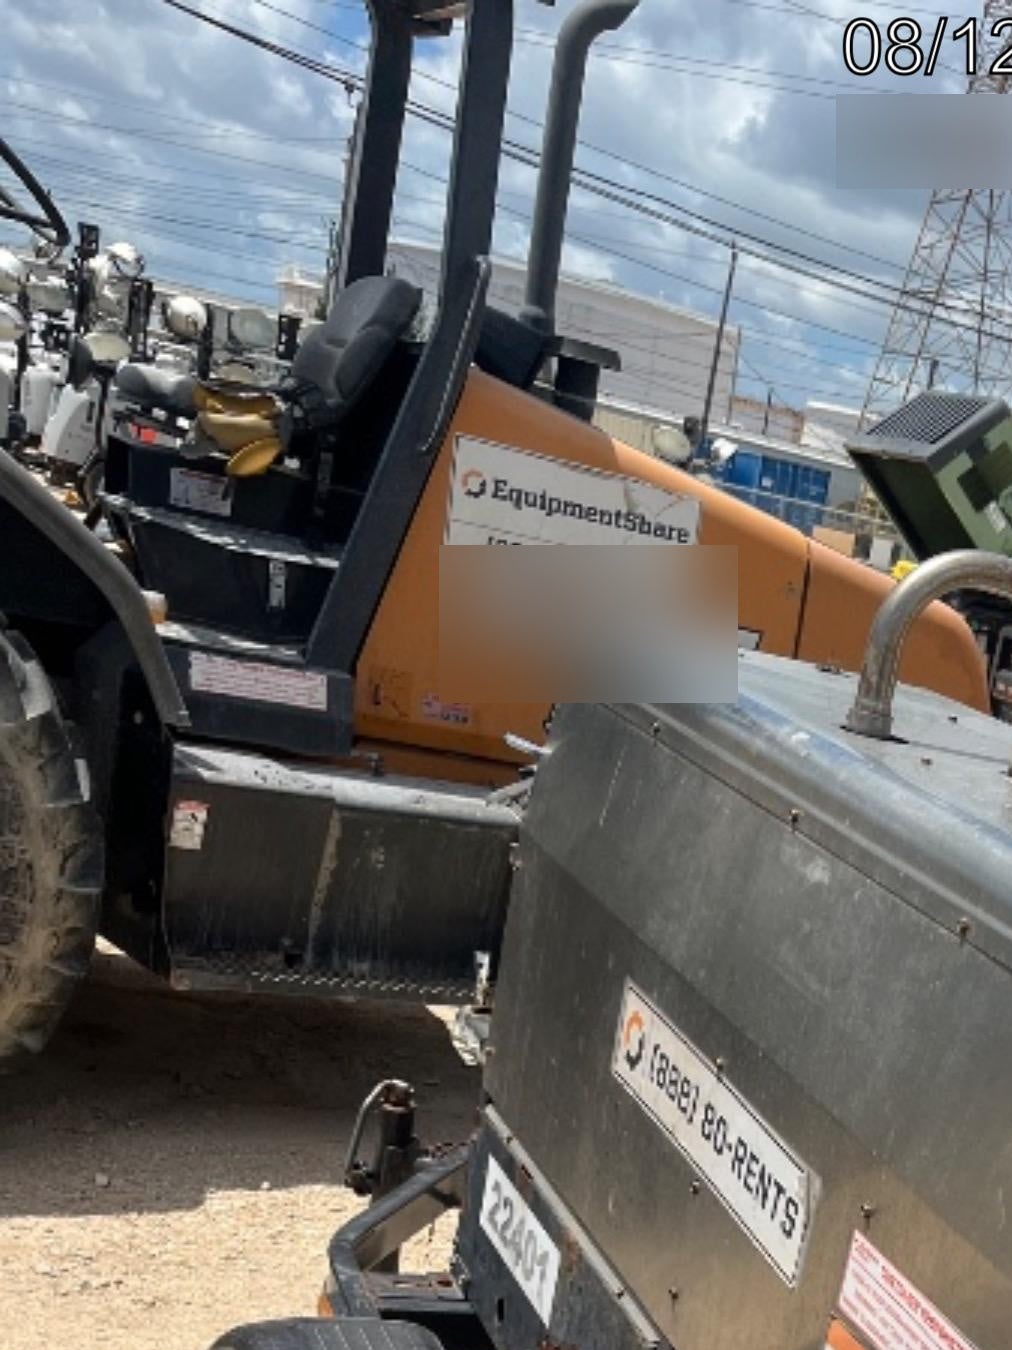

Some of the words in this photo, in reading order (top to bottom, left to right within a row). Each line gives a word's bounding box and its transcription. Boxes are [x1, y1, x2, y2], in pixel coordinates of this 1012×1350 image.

[491, 479, 690, 544] EquipmentShare
[701, 1102, 800, 1240] 80-RENTS
[487, 1180, 550, 1309] 22401
